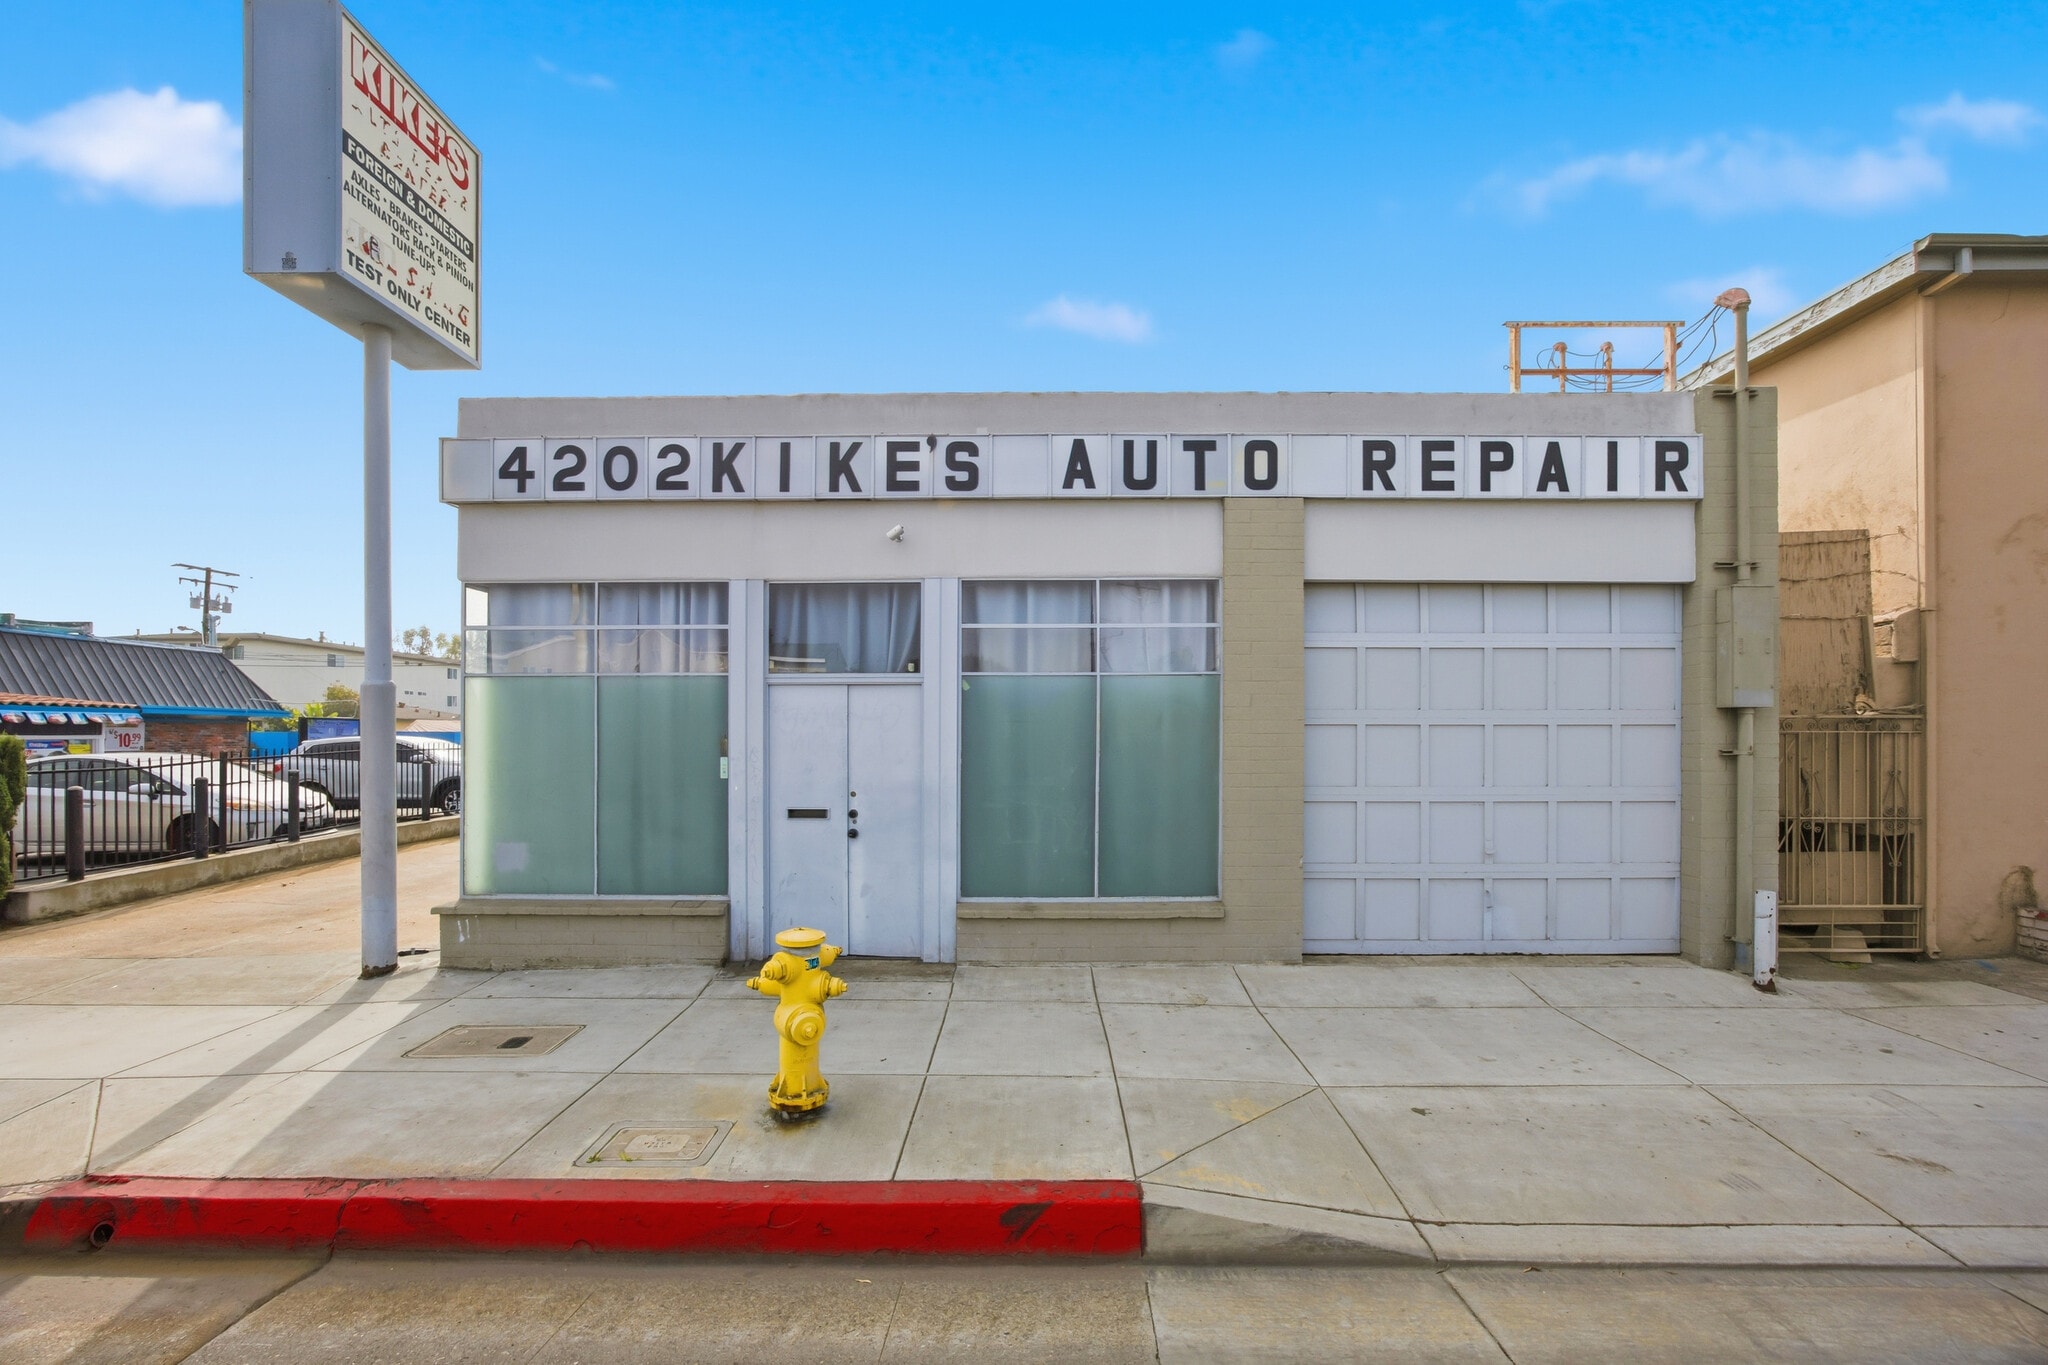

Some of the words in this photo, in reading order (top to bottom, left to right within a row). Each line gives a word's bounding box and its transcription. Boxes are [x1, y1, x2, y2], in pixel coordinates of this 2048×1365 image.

[351, 31, 468, 190] KIKE'S
[343, 179, 410, 241] ALTERNATORS
[412, 235, 435, 264] RACK
[437, 255, 443, 268] &
[446, 262, 474, 292] PINION
[347, 138, 404, 198] FOREIGN
[406, 190, 416, 209] &
[418, 200, 471, 255] DOMESTIC
[351, 169, 380, 202] AXLES
[389, 201, 423, 237] BRAKES
[431, 235, 466, 273] STARTERS
[346, 248, 383, 286] TEST
[387, 279, 422, 312] ONLY
[425, 306, 471, 348] CENTER
[391, 232, 436, 276] TUNE-UPS
[498, 443, 691, 493] 4202
[712, 434, 980, 493] KIKE'S
[1062, 438, 1279, 492] AUTO
[1361, 440, 1690, 492] REPAIR
